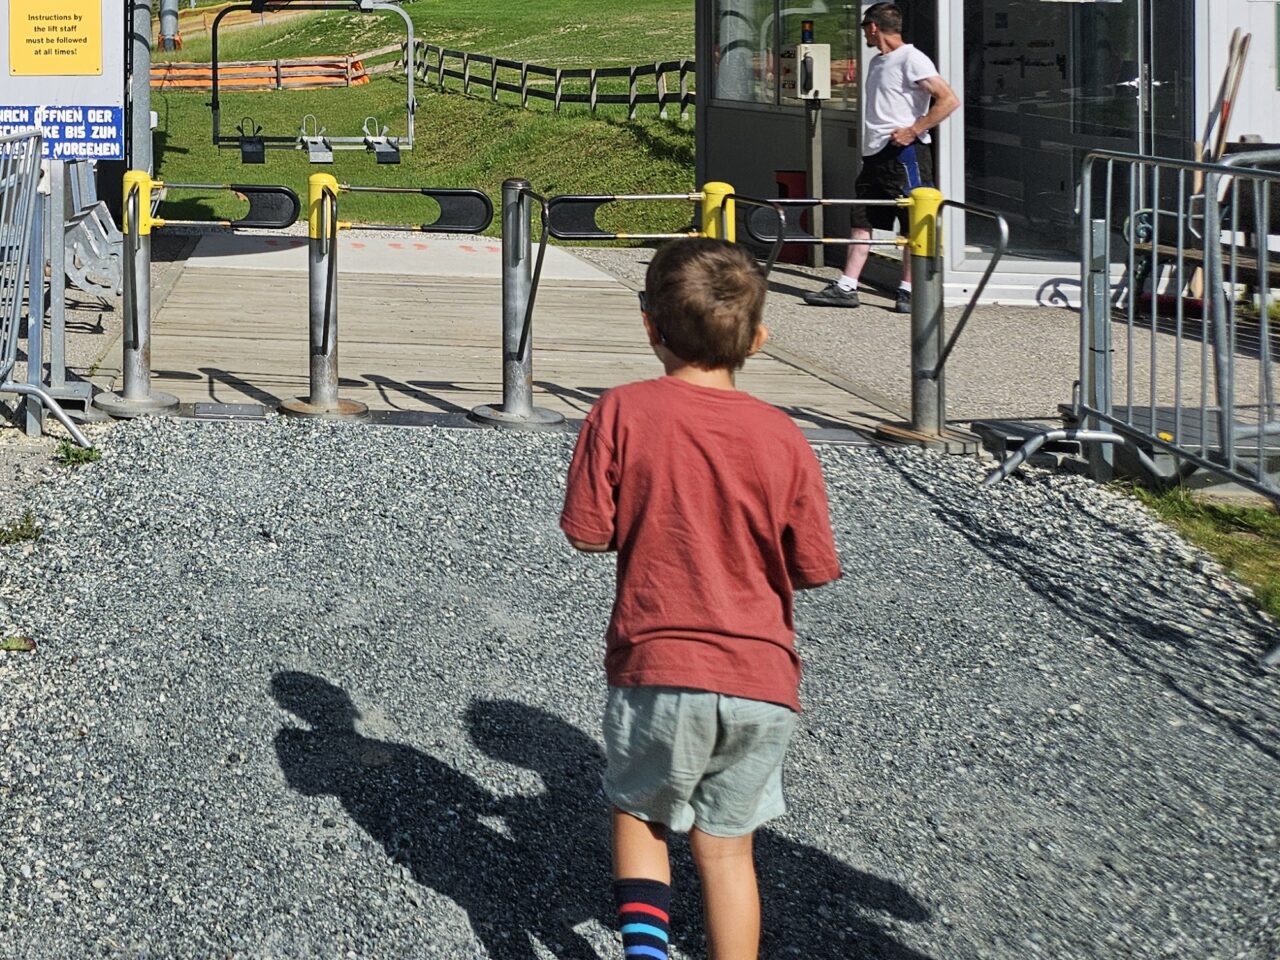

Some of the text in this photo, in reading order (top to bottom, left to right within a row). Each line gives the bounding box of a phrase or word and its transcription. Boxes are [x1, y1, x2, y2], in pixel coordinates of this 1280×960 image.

[73, 14, 83, 22] by
[56, 36, 88, 44] followed
[87, 109, 113, 122] DER
[65, 125, 86, 139] BIS
[90, 125, 117, 139] ZUM
[54, 142, 120, 156] VORGEHEN
